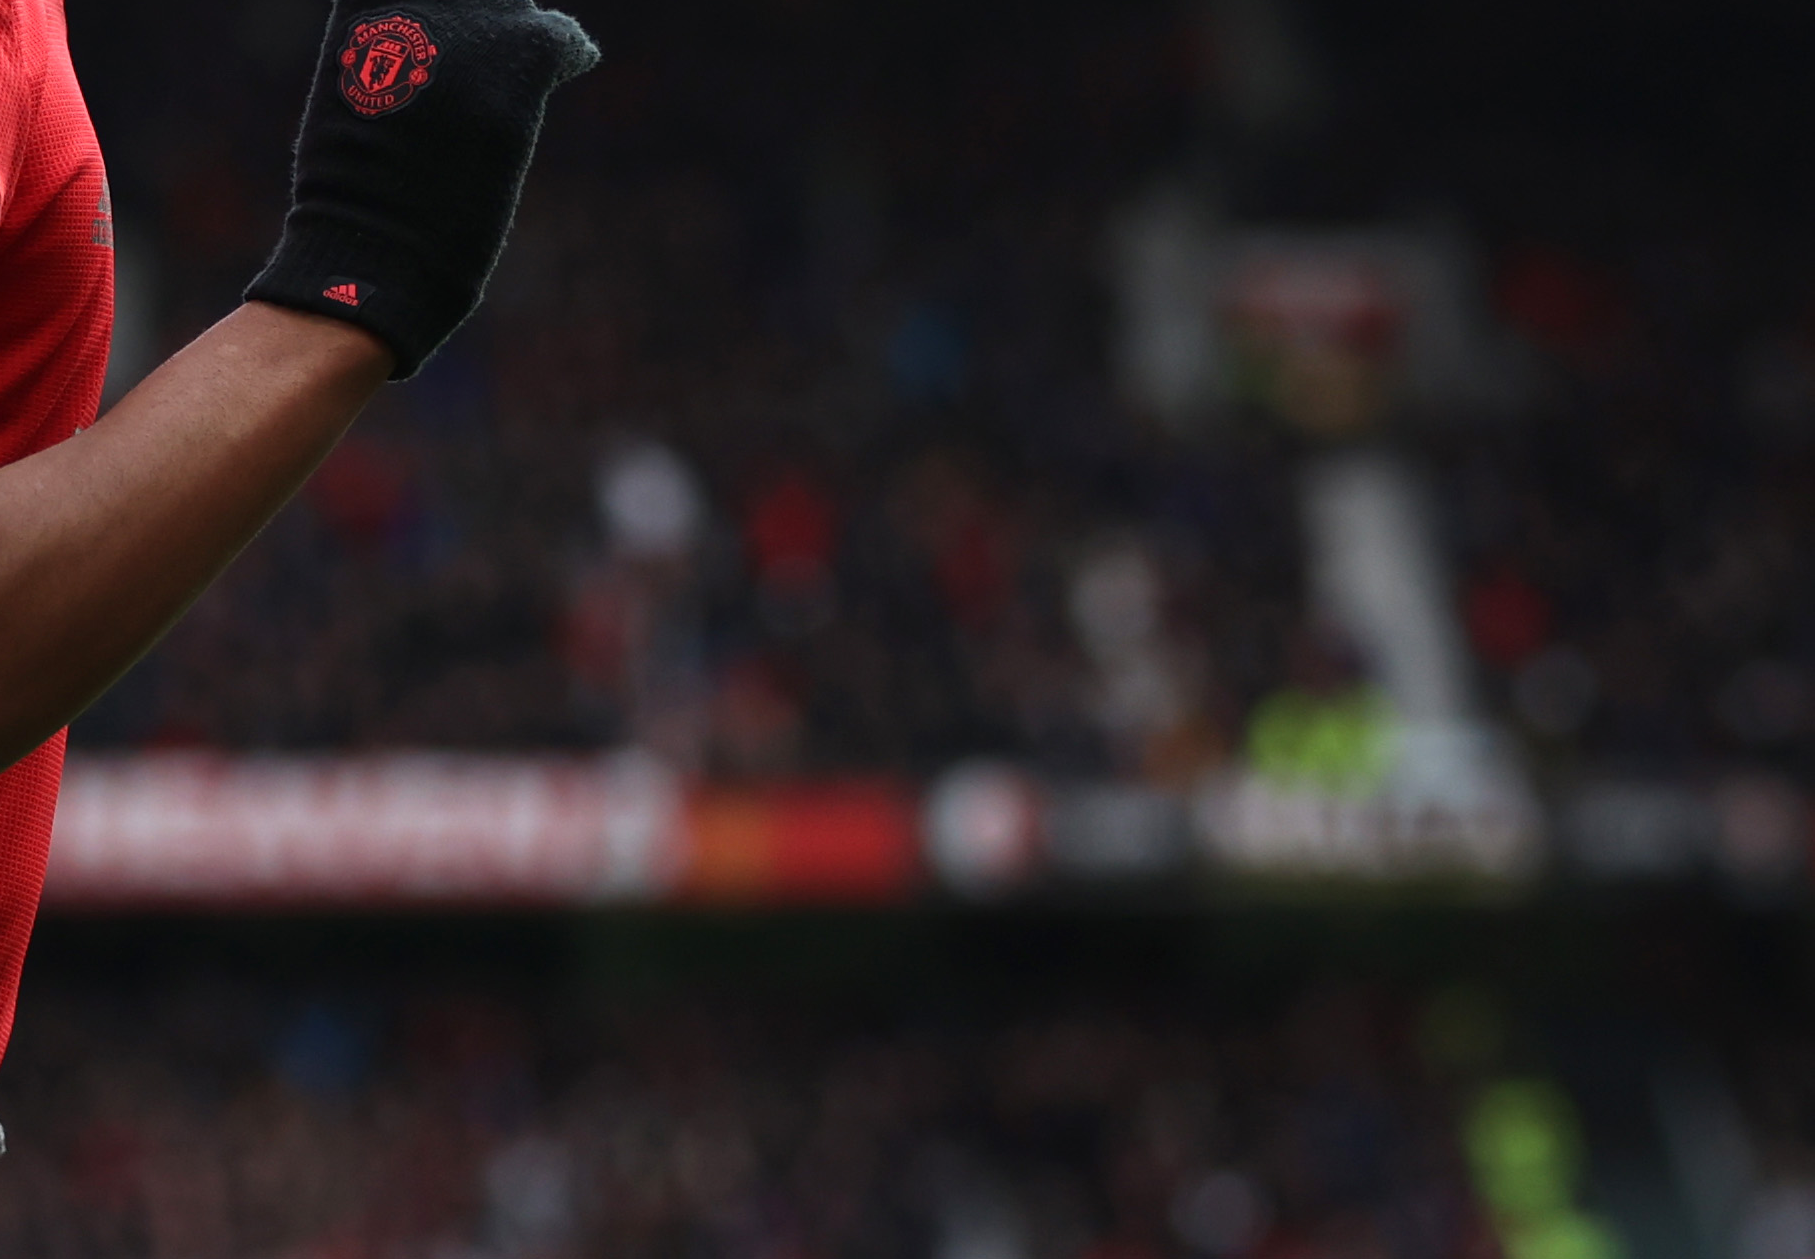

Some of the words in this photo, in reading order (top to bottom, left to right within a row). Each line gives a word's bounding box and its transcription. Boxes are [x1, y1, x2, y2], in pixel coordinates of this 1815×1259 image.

[357, 22, 427, 61] MANCHESTER
[347, 85, 395, 107] UNITED
[322, 290, 359, 306] adidas
